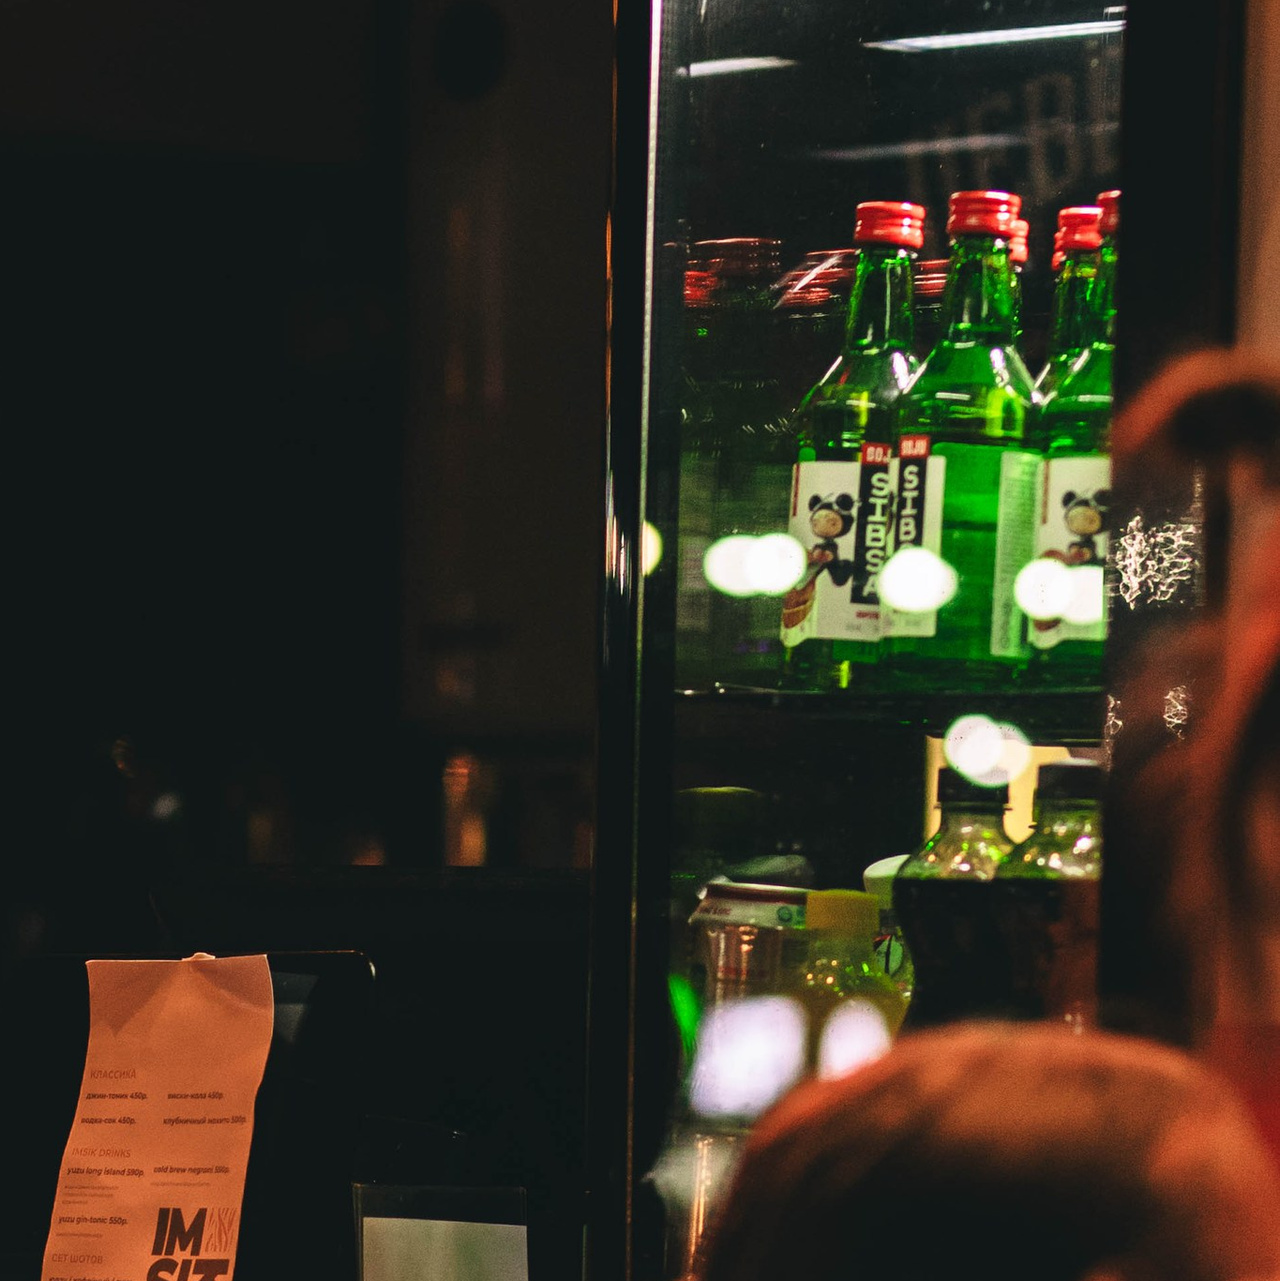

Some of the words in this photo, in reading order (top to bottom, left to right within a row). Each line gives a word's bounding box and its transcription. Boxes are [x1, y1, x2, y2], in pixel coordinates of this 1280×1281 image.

[899, 465, 920, 550] SIB
[90, 1069, 137, 1080] КЛАССИКА
[72, 1147, 97, 1157] IMSIK
[98, 1148, 131, 1158] DRINKS
[67, 1167, 85, 1175] yuzu
[85, 1166, 102, 1176] long
[58, 1216, 75, 1224] yuzu
[151, 1207, 208, 1257] IM
[52, 1253, 70, 1263] СЕТ
[70, 1254, 104, 1264] ШОТОВ
